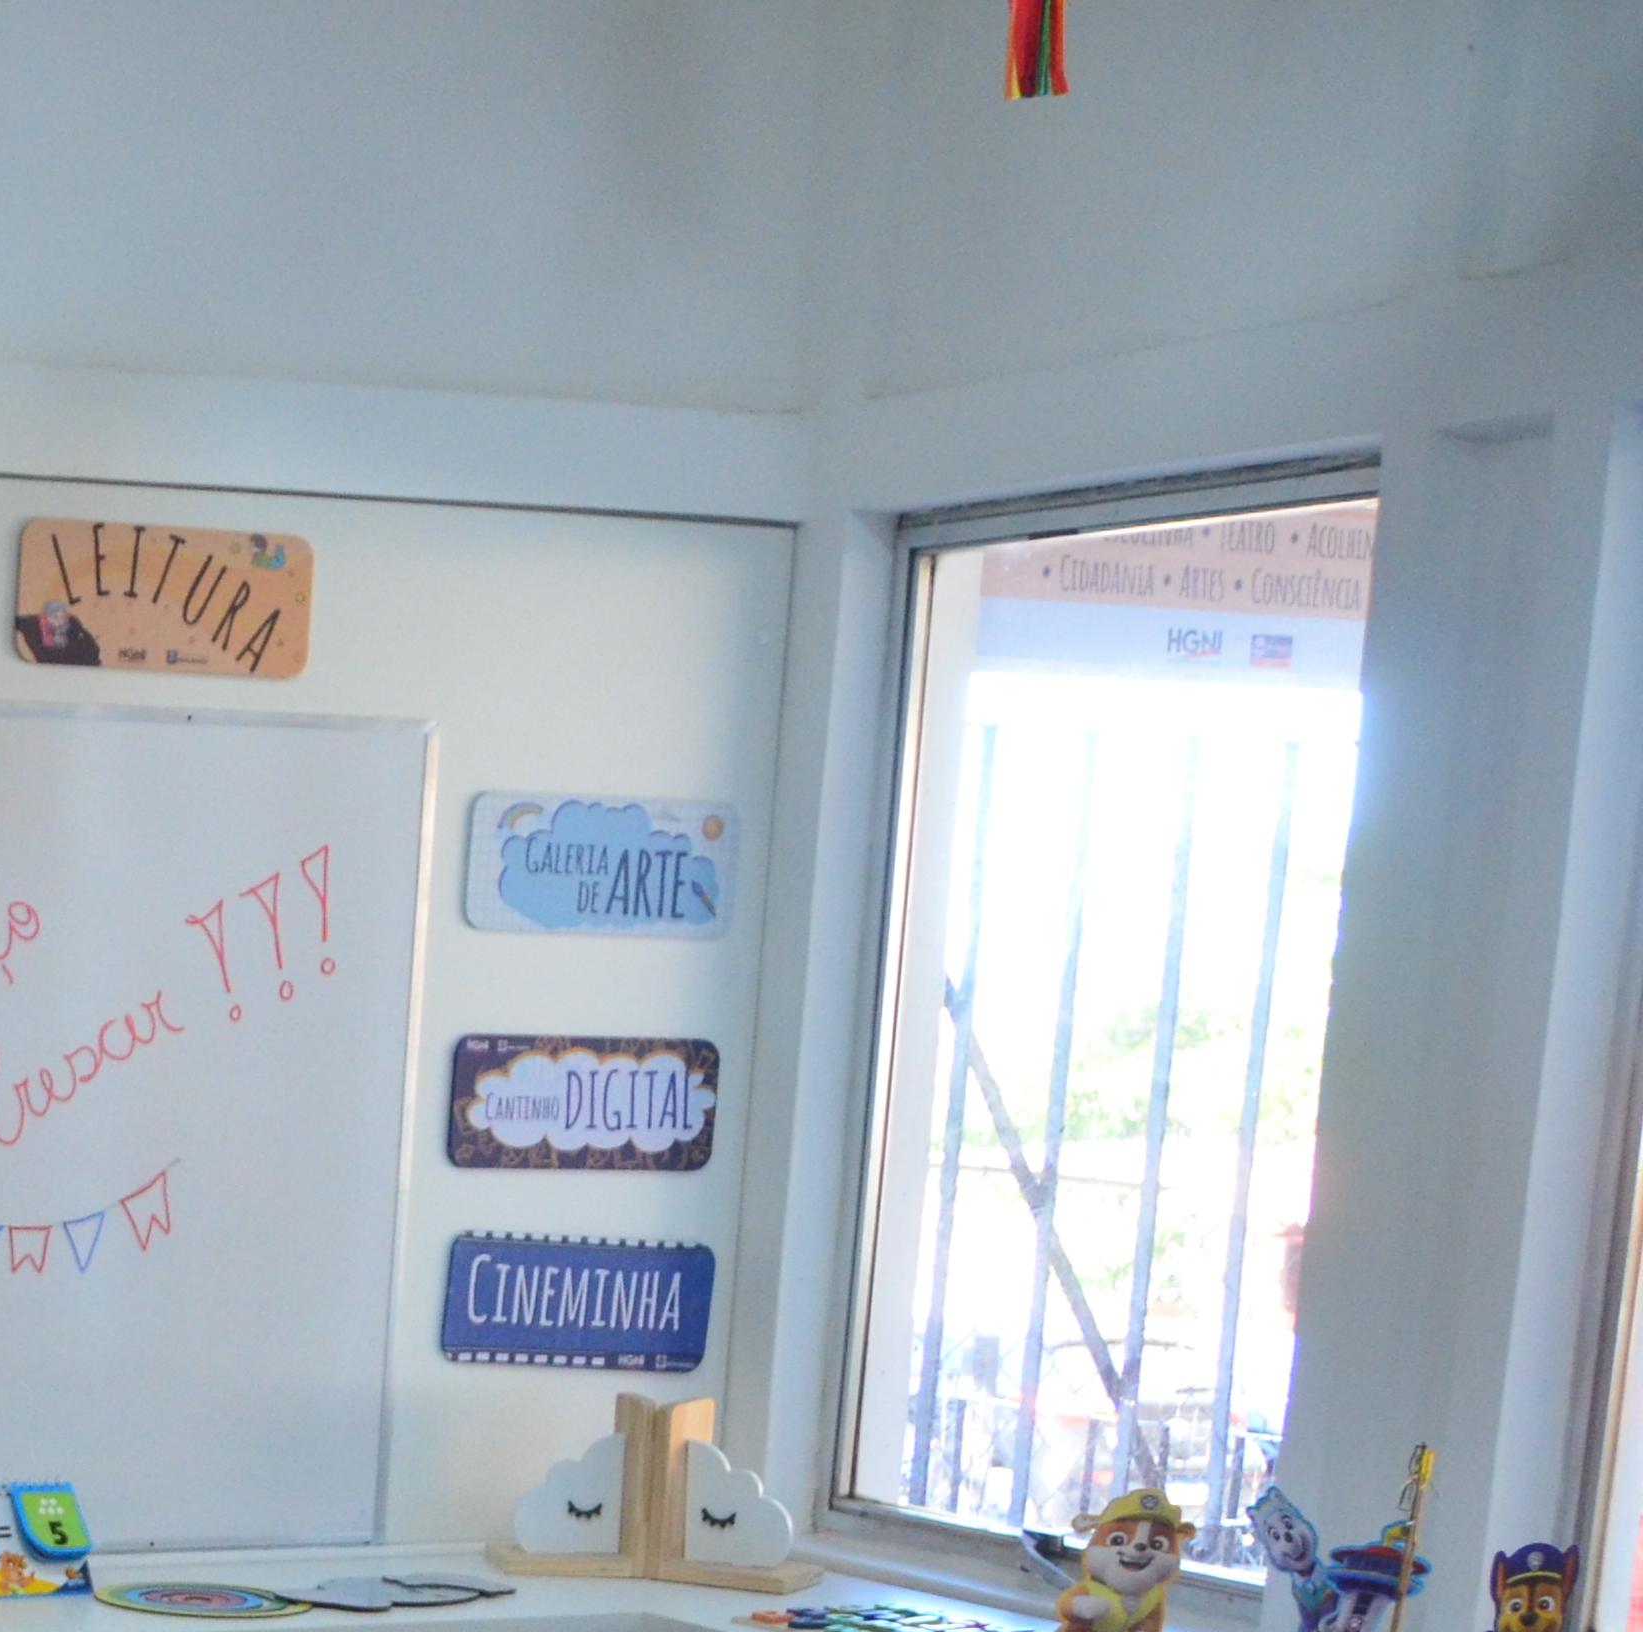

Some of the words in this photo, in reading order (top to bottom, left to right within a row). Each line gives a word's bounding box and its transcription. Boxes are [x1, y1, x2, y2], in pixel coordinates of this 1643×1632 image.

[51, 521, 282, 673] LEITURA
[1059, 554, 1155, 597] CIDADANIA
[1178, 564, 1226, 600] ARTES
[1250, 566, 1362, 611] CONSCIÊNCIA
[1167, 628, 1223, 653] HGNI
[524, 834, 610, 877] GALERIA
[576, 880, 600, 913] DE
[606, 848, 691, 920] ARTE
[484, 1090, 561, 1123] CANTINHO
[563, 1068, 694, 1133] DIGITAL
[467, 1252, 682, 1333] CINEMINHA
[47, 1520, 69, 1546] 5
